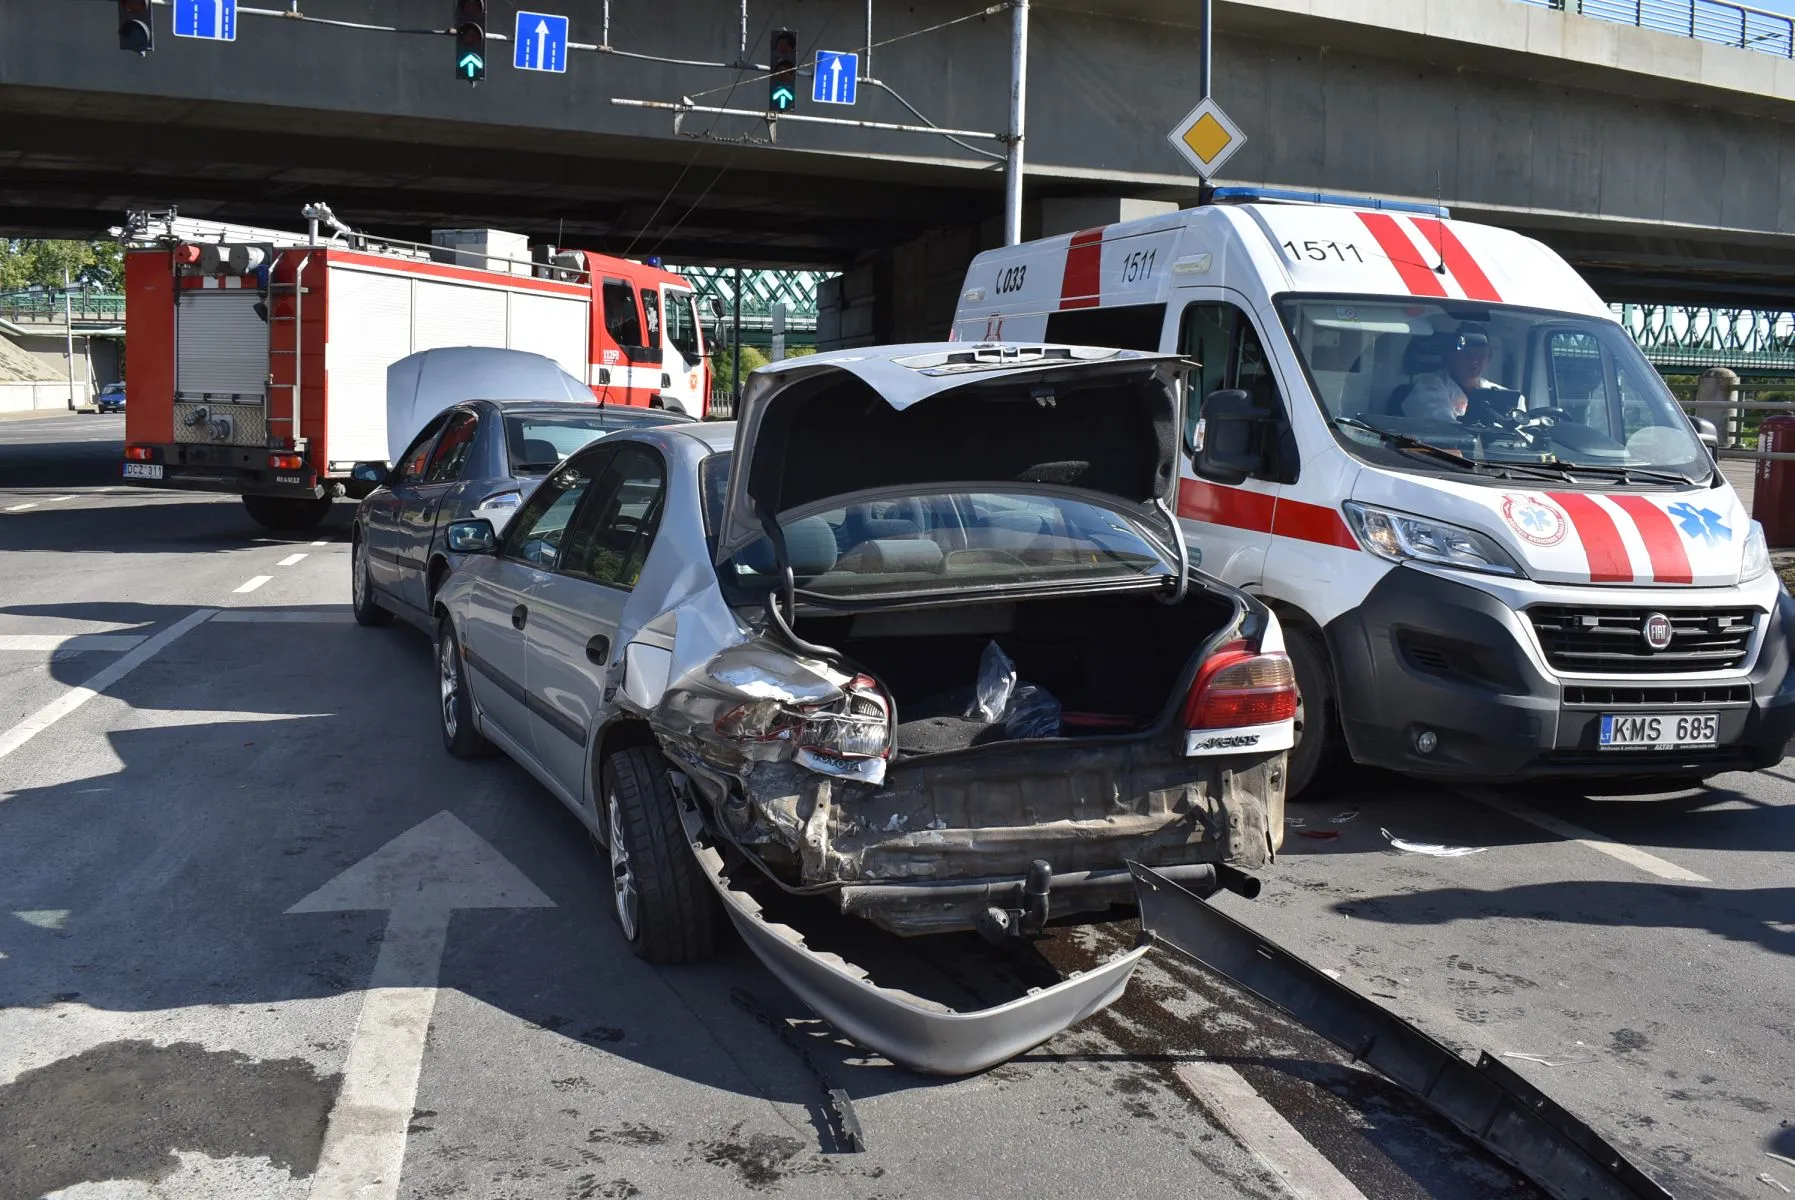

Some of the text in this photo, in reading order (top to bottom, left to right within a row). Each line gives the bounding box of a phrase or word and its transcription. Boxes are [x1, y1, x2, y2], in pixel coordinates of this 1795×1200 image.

[1283, 240, 1363, 263] 1511
[1122, 248, 1157, 283] 1511
[1002, 264, 1027, 293] 033
[128, 464, 162, 477] DCZ 311
[1651, 624, 1667, 640] FIAT
[1601, 717, 1715, 742] LT KMS 685
[1193, 734, 1260, 751] AVENSIS
[812, 752, 862, 772] TOYOTA
